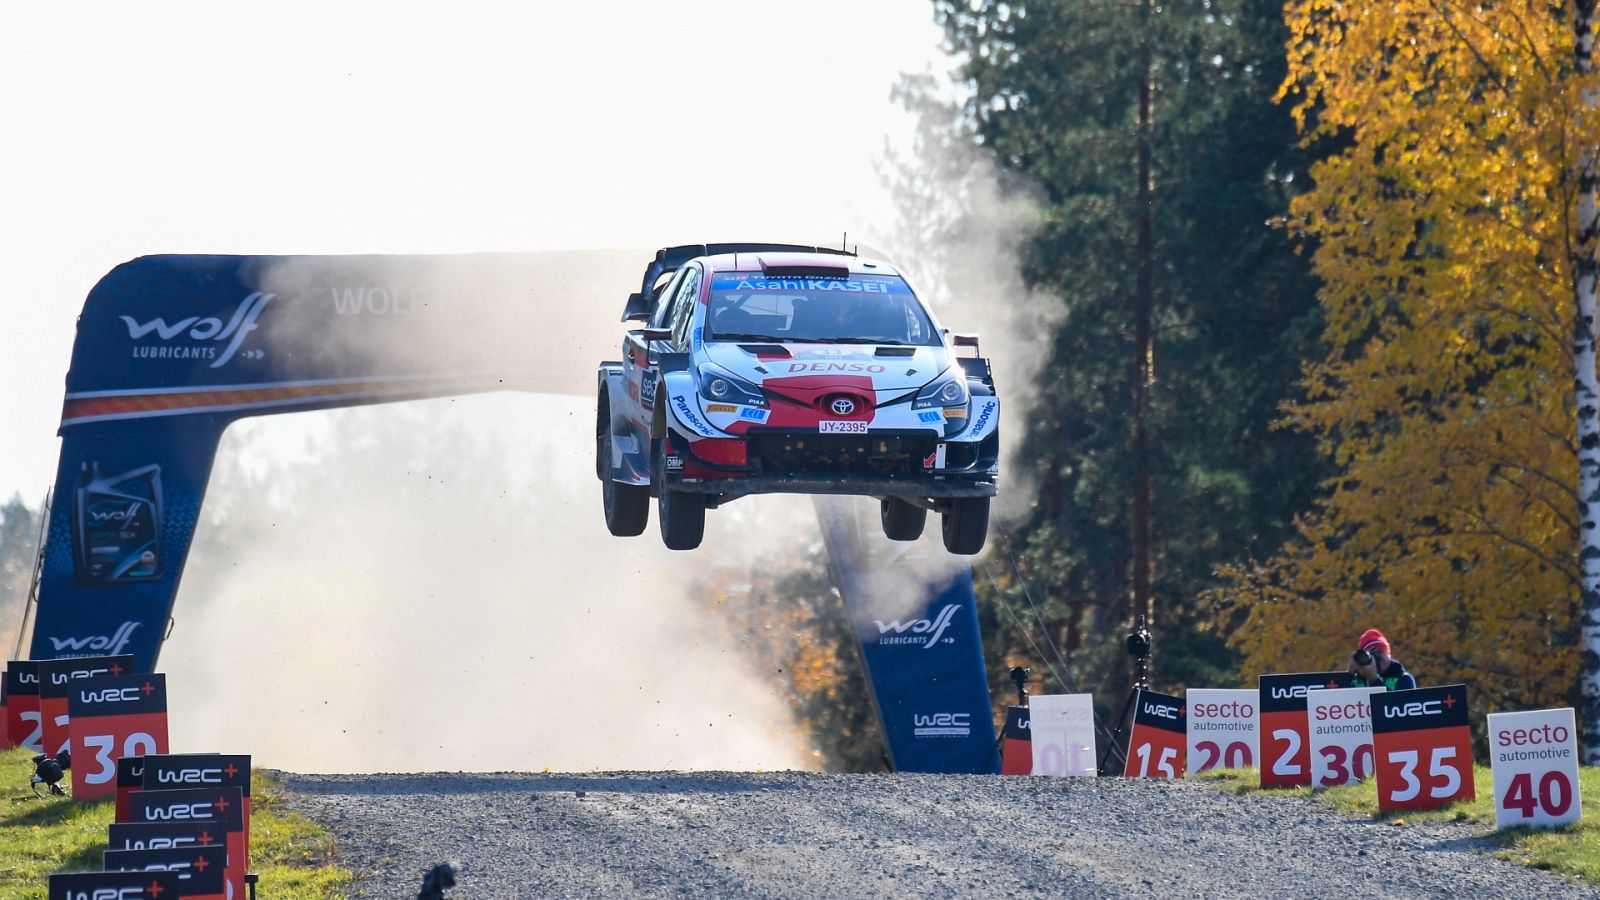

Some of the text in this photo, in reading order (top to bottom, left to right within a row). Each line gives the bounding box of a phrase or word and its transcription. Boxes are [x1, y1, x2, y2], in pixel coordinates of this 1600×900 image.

[133, 346, 216, 359] LUBRICANTS
[789, 363, 886, 374] DENSO
[672, 395, 714, 436] Panasonic
[821, 422, 866, 432] JY-2395
[666, 459, 683, 467] OMP
[880, 637, 927, 645] LUBRICANTS
[1194, 701, 1253, 718] secto
[1316, 701, 1372, 720] sect
[914, 713, 970, 726] WRC
[1193, 721, 1254, 731] automotive
[1316, 722, 1373, 735] automotiv
[1498, 724, 1568, 747] secto
[1137, 743, 1178, 778] 15
[1194, 741, 1253, 774] 20
[1272, 729, 1311, 776] 2
[1500, 746, 1570, 762] automotive
[1319, 744, 1375, 786] 30
[1388, 746, 1461, 802] 35
[1503, 771, 1572, 818] 40
